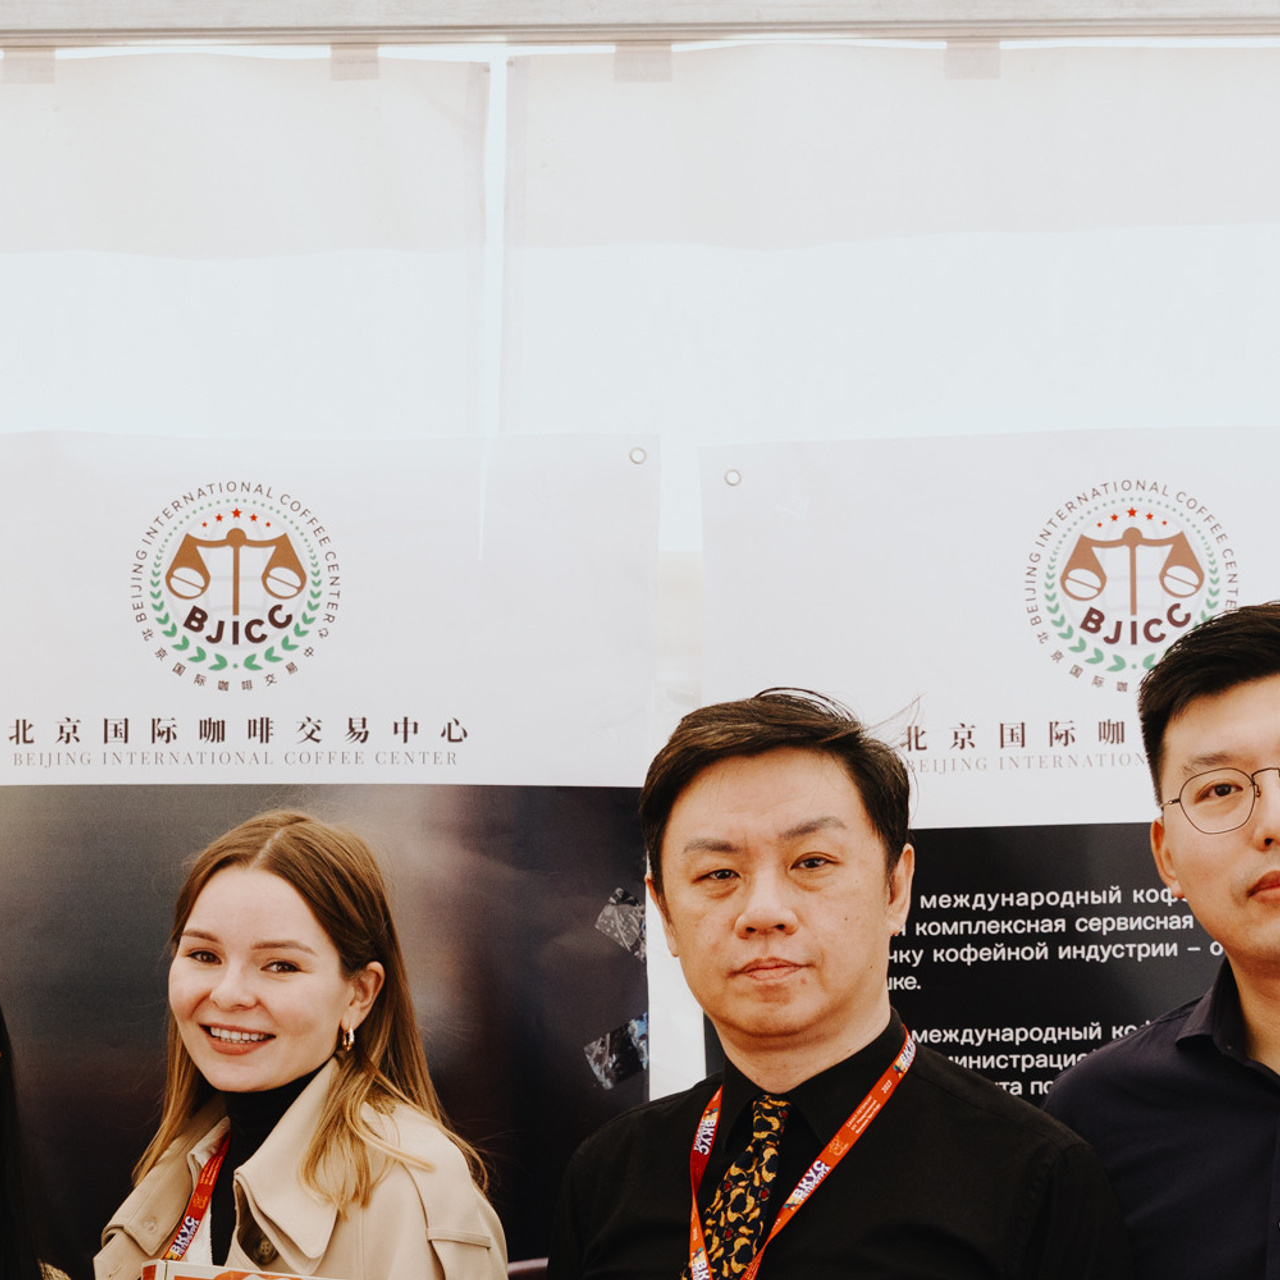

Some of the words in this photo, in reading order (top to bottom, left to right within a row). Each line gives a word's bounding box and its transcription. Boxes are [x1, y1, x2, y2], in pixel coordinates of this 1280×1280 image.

[130, 549, 148, 623] BEIJING
[144, 481, 274, 546] INTERNATIONAL
[280, 493, 331, 548] COFFEE
[322, 551, 341, 624] CENTER
[1025, 551, 1042, 626] BEIJING
[1035, 479, 1170, 548] INTERNATIONAL
[1176, 491, 1228, 544] COFFEE
[1222, 548, 1239, 609] CENTE
[183, 604, 293, 645] BJICC
[1080, 603, 1191, 645] BJICC
[8, 716, 468, 746] 北京国际咖啡交易中心
[13, 752, 91, 768] BEIJING
[103, 751, 274, 767] INTERNATIONAL
[284, 750, 365, 766] COFFEE
[375, 750, 458, 766] CENTER
[919, 886, 1122, 911] международный
[1132, 887, 1188, 907] коф
[915, 917, 1066, 937] комплексная
[1075, 914, 1194, 936] сервисная
[933, 941, 1049, 966] кофейной
[1058, 941, 1178, 963] индустрии
[911, 1021, 1102, 1046] международный
[946, 1049, 1098, 1073] инистраци
[994, 1080, 1022, 1095] та
[792, 1160, 826, 1199] ВКУС
[170, 1216, 195, 1253] ВКУС
